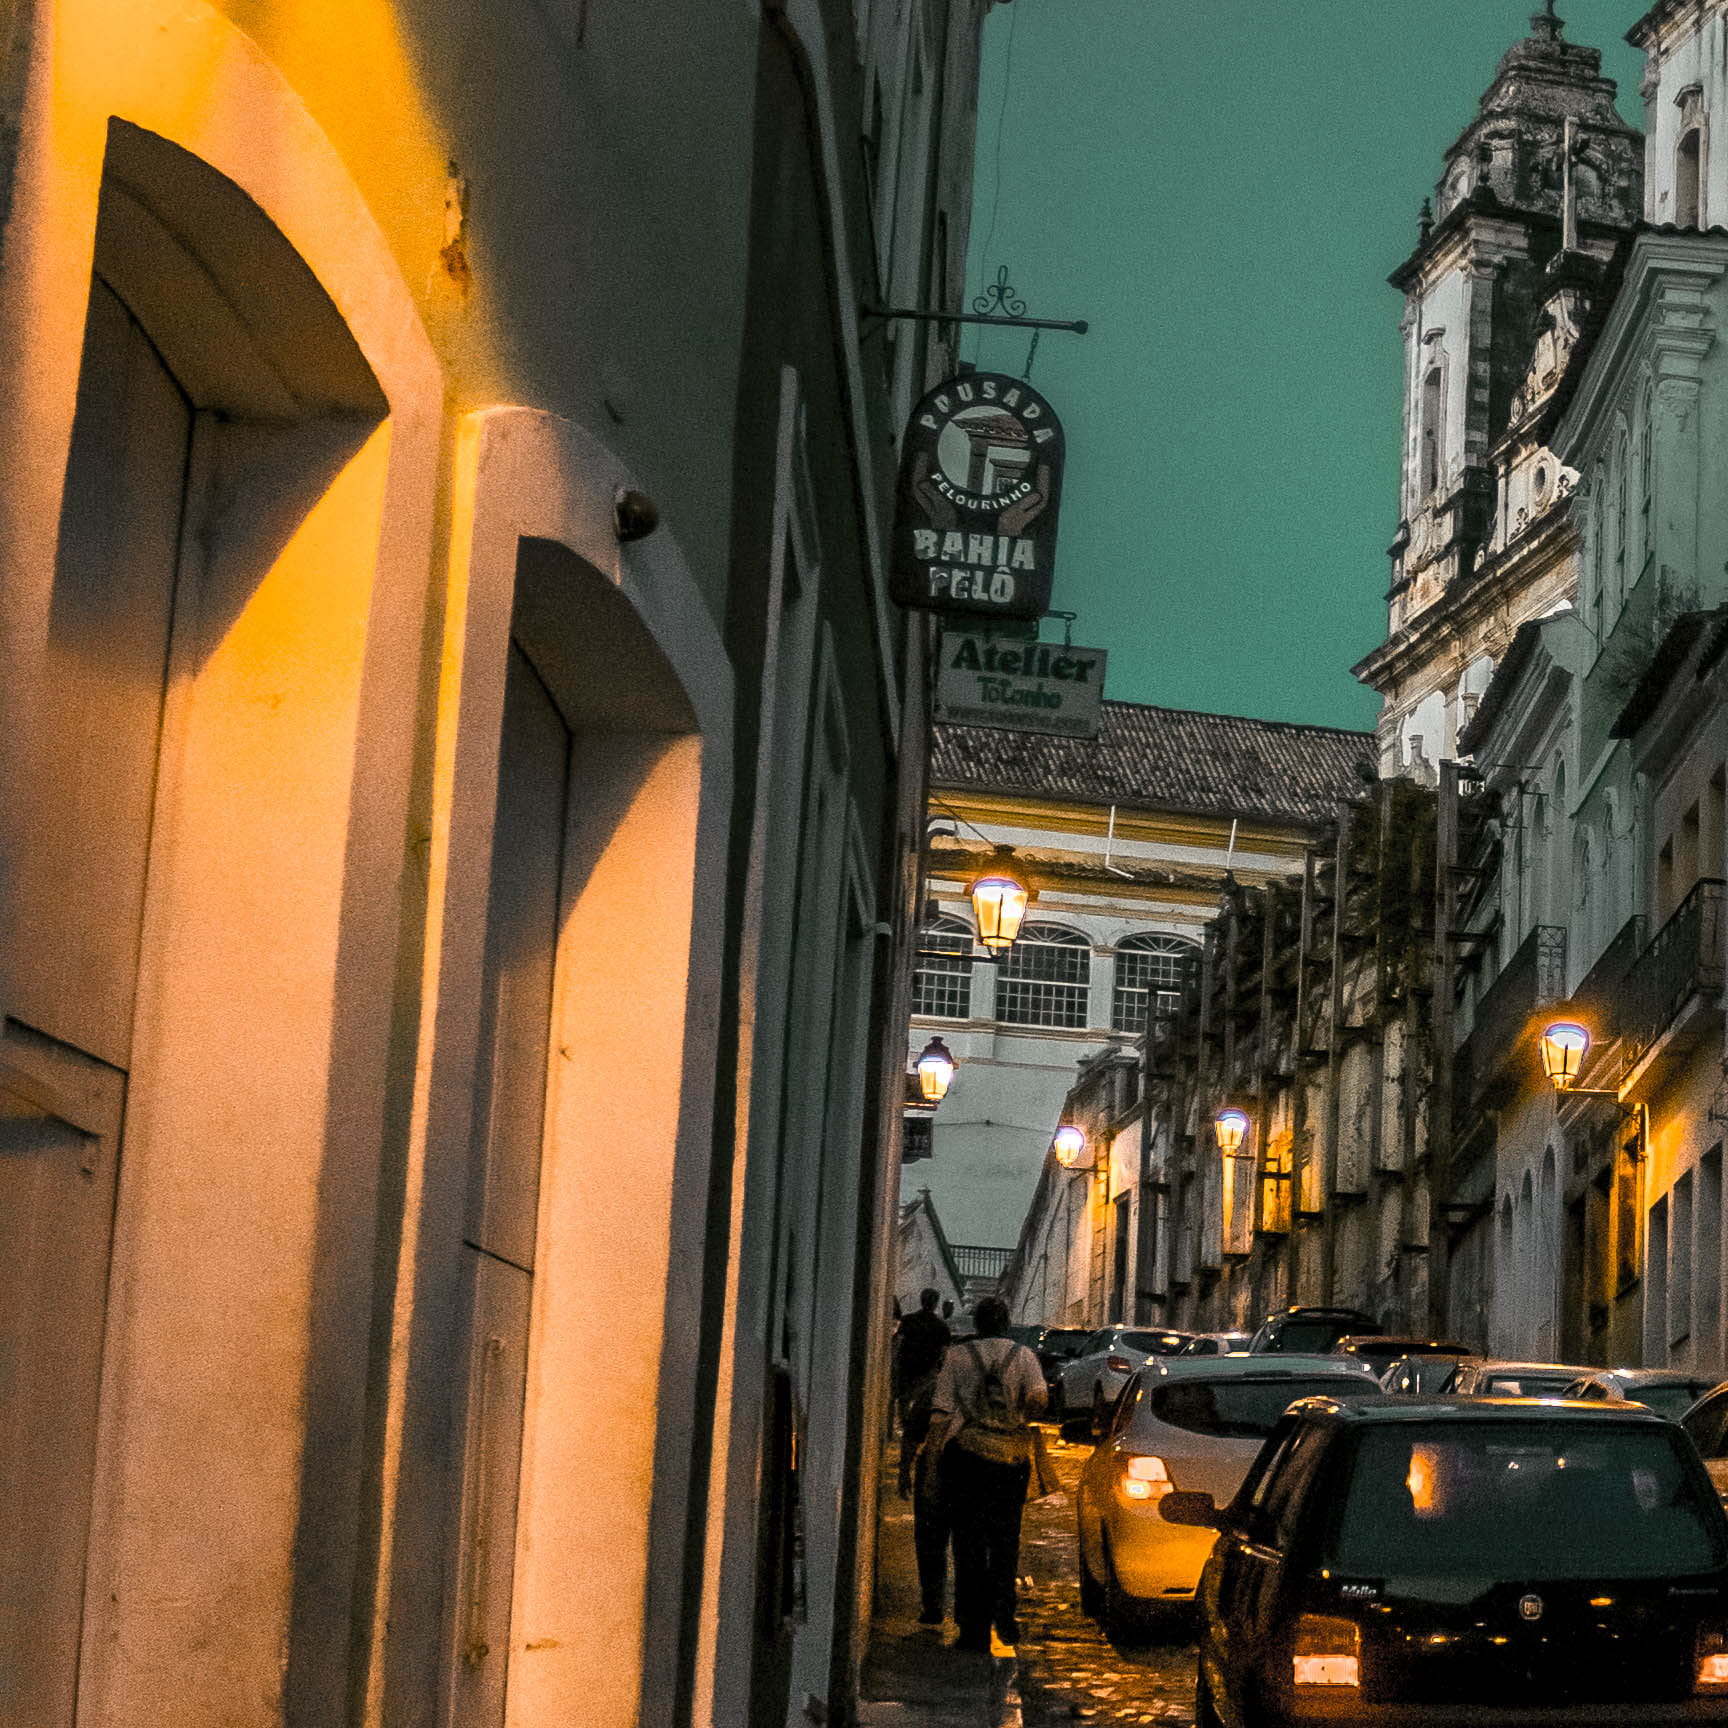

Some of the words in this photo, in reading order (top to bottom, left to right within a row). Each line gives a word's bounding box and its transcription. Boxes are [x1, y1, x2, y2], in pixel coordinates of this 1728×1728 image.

[920, 381, 1054, 444] POUSADA
[931, 472, 1032, 511] PELOURINHO
[913, 529, 1036, 571] BAHIA
[928, 566, 1016, 604] PELÔ
[951, 638, 1096, 684] Atelier
